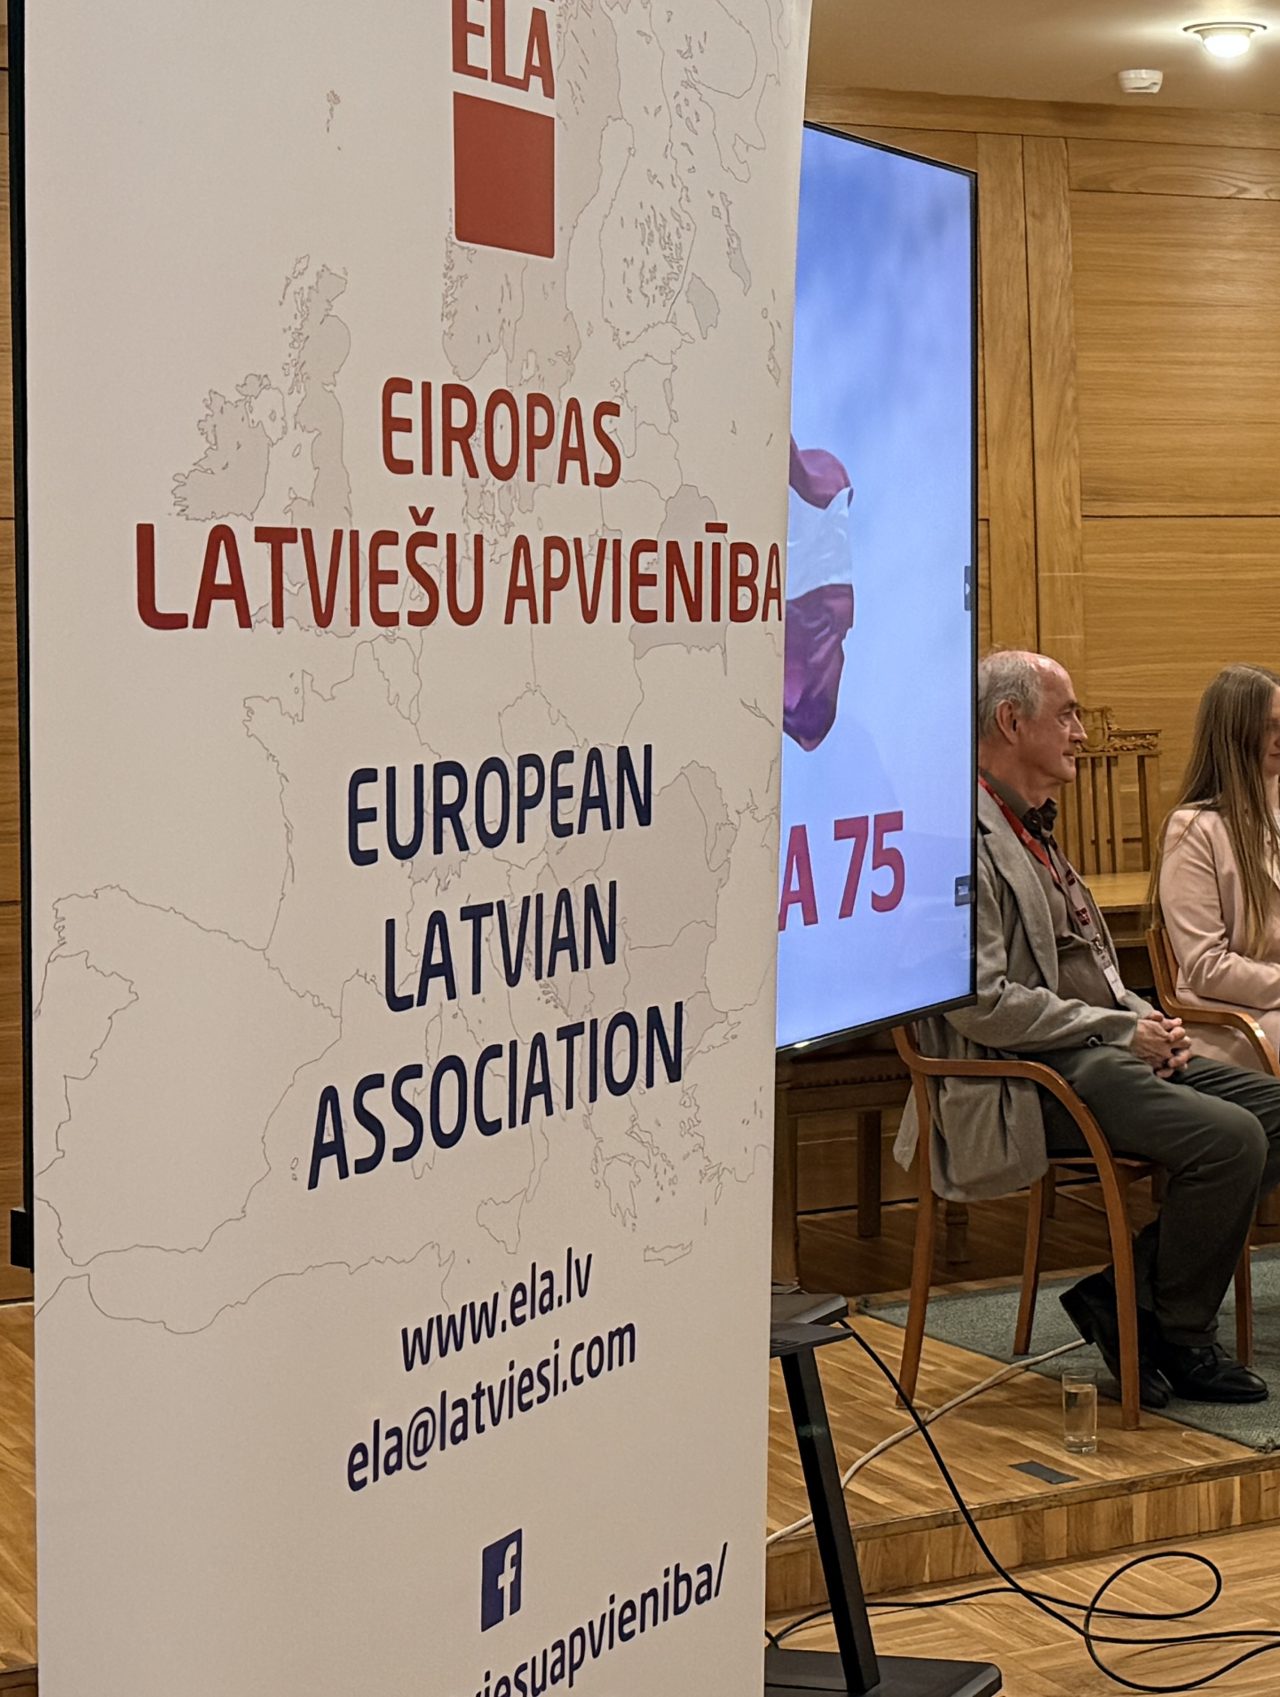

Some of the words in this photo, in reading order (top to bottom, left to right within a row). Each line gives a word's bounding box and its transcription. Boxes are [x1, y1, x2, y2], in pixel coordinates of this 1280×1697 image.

[451, 0, 555, 100] ELA
[381, 377, 622, 488] EIROPAS
[136, 507, 484, 631] LATVIEŠU
[504, 522, 783, 625] APVIENĪBA
[348, 743, 654, 867] EUROPEAN
[833, 810, 906, 920] 75
[384, 880, 618, 1012] LATVIAN
[307, 1001, 685, 1191] ASSOCIATION
[401, 1246, 593, 1373] www.ela.lv
[347, 1322, 637, 1492] ela@latviesi.com
